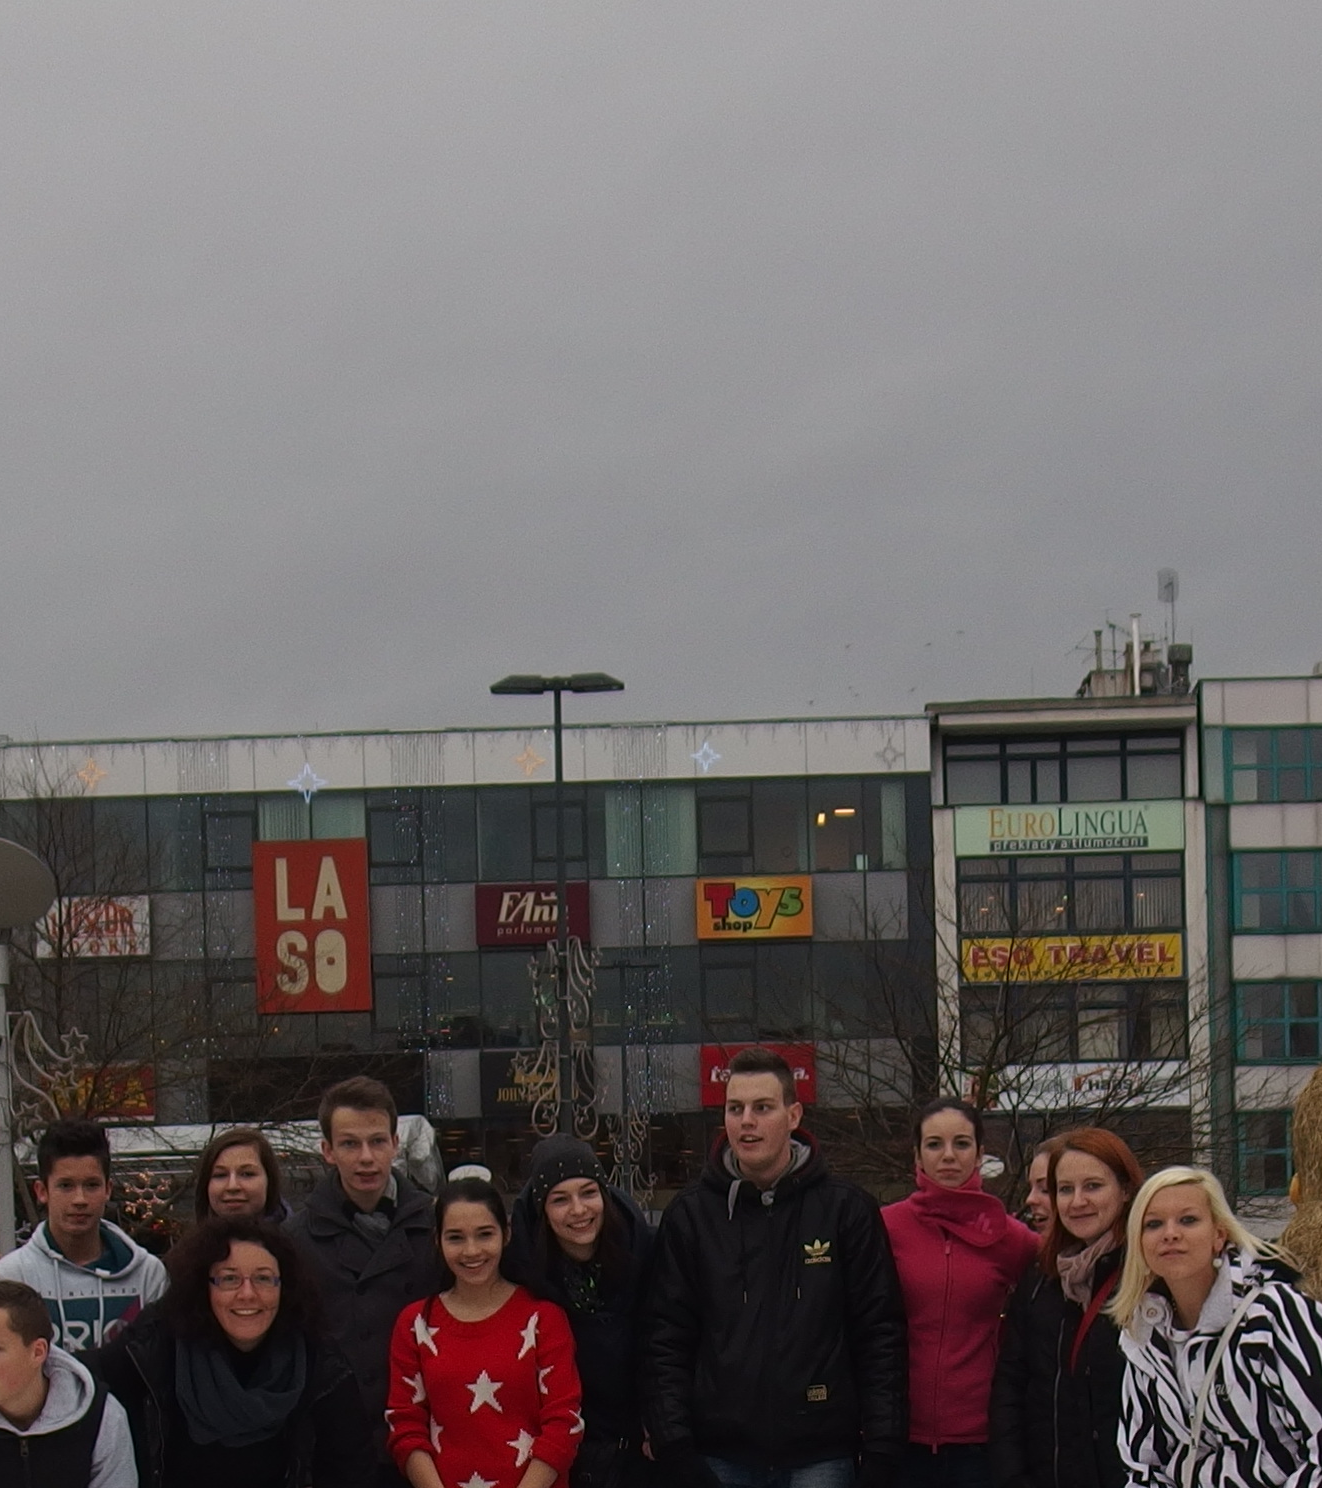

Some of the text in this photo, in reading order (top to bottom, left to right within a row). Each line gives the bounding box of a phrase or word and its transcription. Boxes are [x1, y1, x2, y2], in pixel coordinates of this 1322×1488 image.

[275, 856, 348, 921] LA
[713, 917, 754, 933] shop
[277, 930, 348, 995] SO
[970, 940, 1175, 968] ESO TRAVEL
